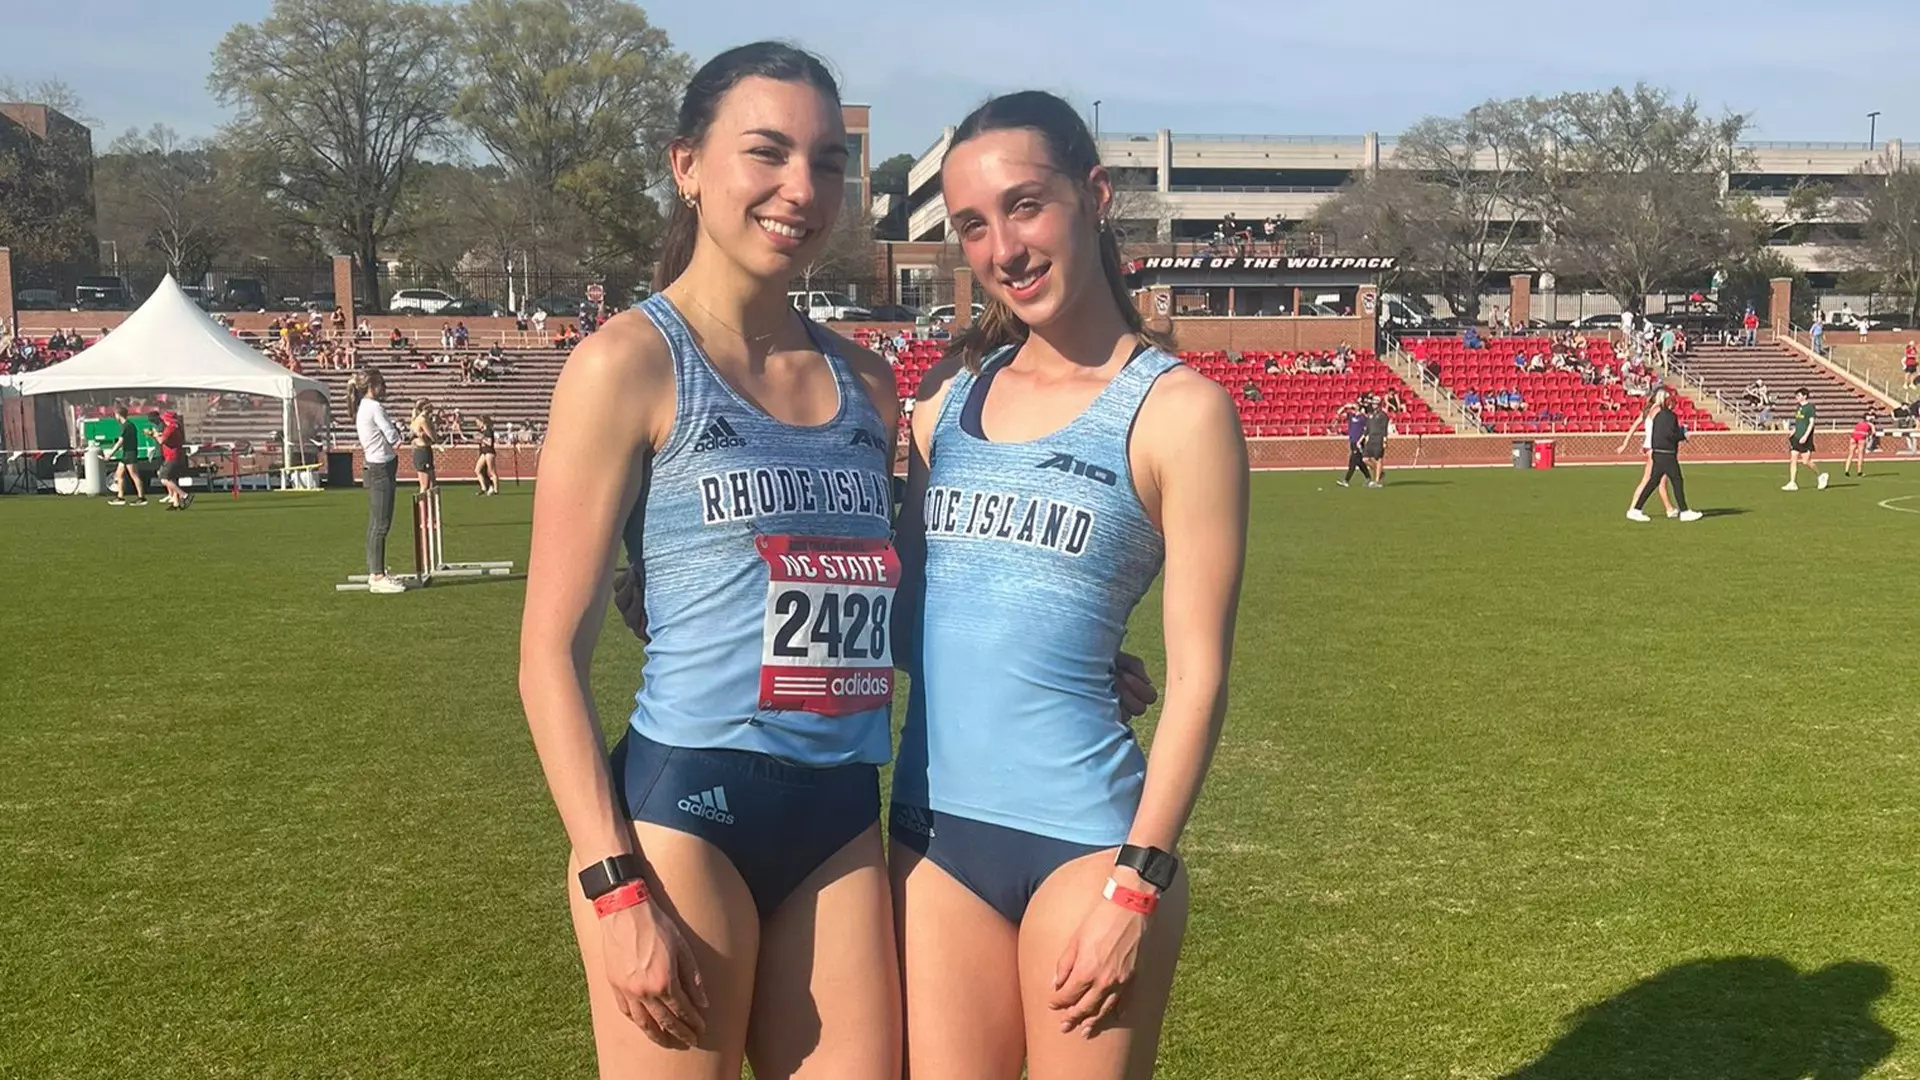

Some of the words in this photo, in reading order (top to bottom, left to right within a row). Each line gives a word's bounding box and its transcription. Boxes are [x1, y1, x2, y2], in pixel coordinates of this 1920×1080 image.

[1146, 257, 1202, 269] HOME
[1210, 257, 1236, 269] OF
[1243, 257, 1279, 269] THE
[1287, 257, 1395, 269] WOLFPACK
[694, 435, 748, 451] adidas
[1036, 452, 1117, 487] A10
[699, 468, 817, 525] RHODE
[964, 490, 1096, 557] ISLAND
[779, 554, 817, 578] NC
[819, 555, 887, 582] STATE
[773, 590, 888, 660] 2428
[831, 672, 889, 696] adidas
[677, 799, 735, 826] adidas
